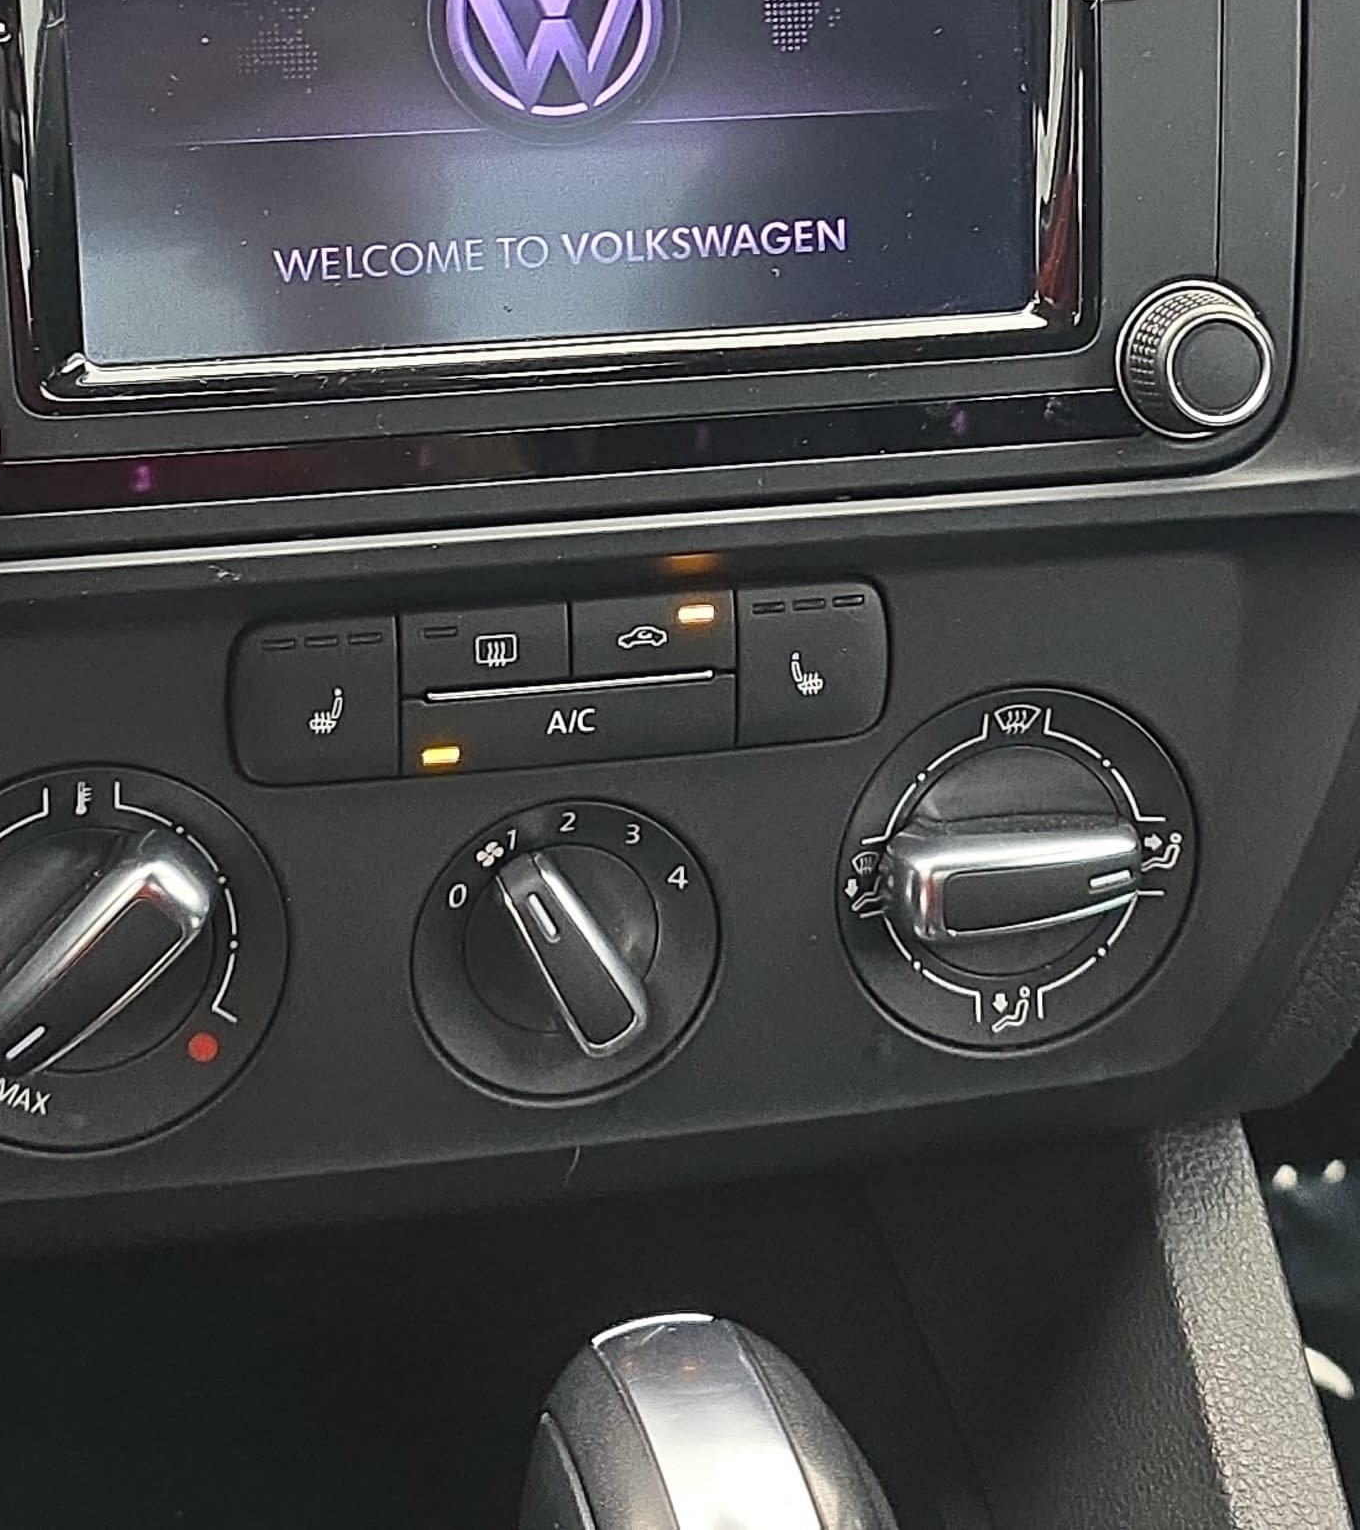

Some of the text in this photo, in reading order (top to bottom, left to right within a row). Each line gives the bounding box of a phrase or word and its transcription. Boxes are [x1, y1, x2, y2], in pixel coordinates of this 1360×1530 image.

[273, 216, 847, 284] WELCOME TO VOLKSWAGEN
[546, 707, 596, 735] A/C
[505, 828, 519, 851] 1
[559, 811, 577, 833] 2
[625, 823, 642, 845] 3
[667, 864, 689, 890] 4
